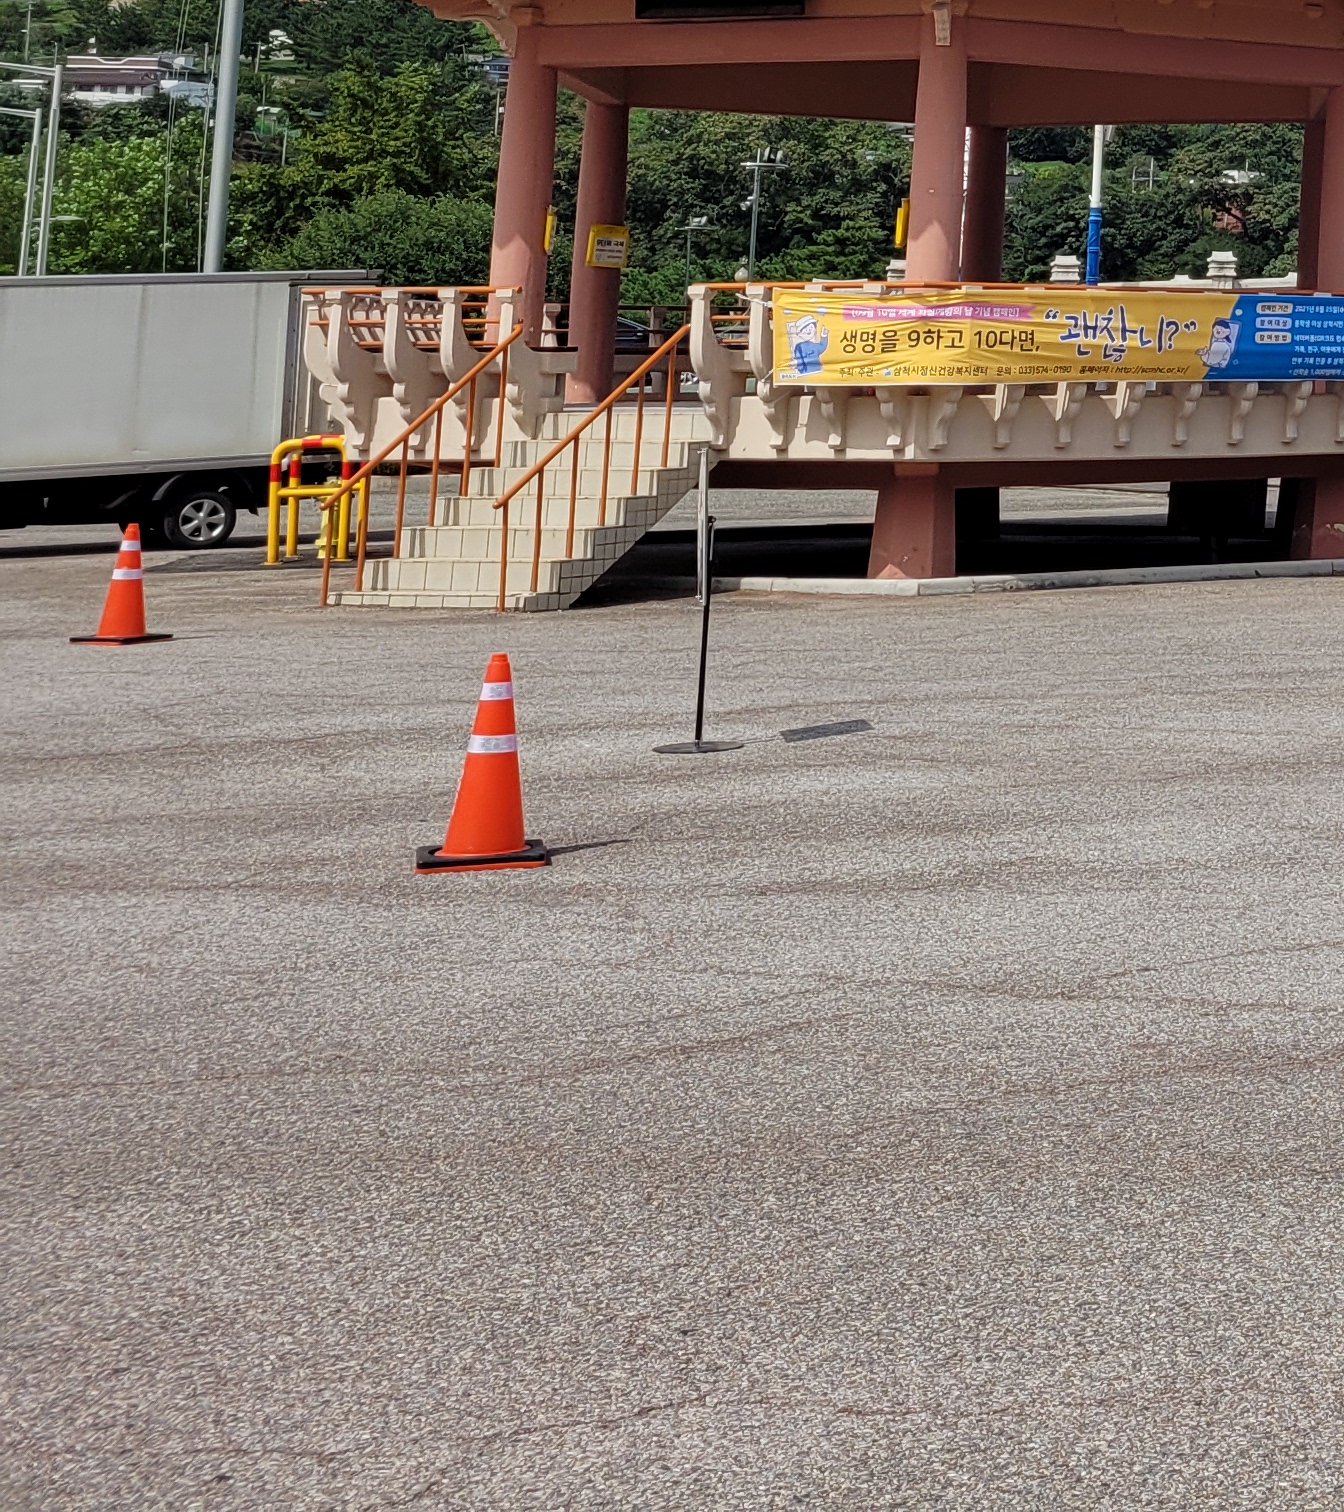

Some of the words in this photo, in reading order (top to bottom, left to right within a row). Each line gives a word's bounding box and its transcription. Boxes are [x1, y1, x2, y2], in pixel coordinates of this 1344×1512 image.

[964, 305, 973, 317] 날
[975, 306, 991, 317] 기념
[839, 328, 901, 354] 생명을
[907, 328, 966, 351] 9하고
[973, 328, 1041, 355] 10다면,
[894, 365, 988, 377] 삼척시정신건강복지센터
[996, 366, 1012, 377] 문의
